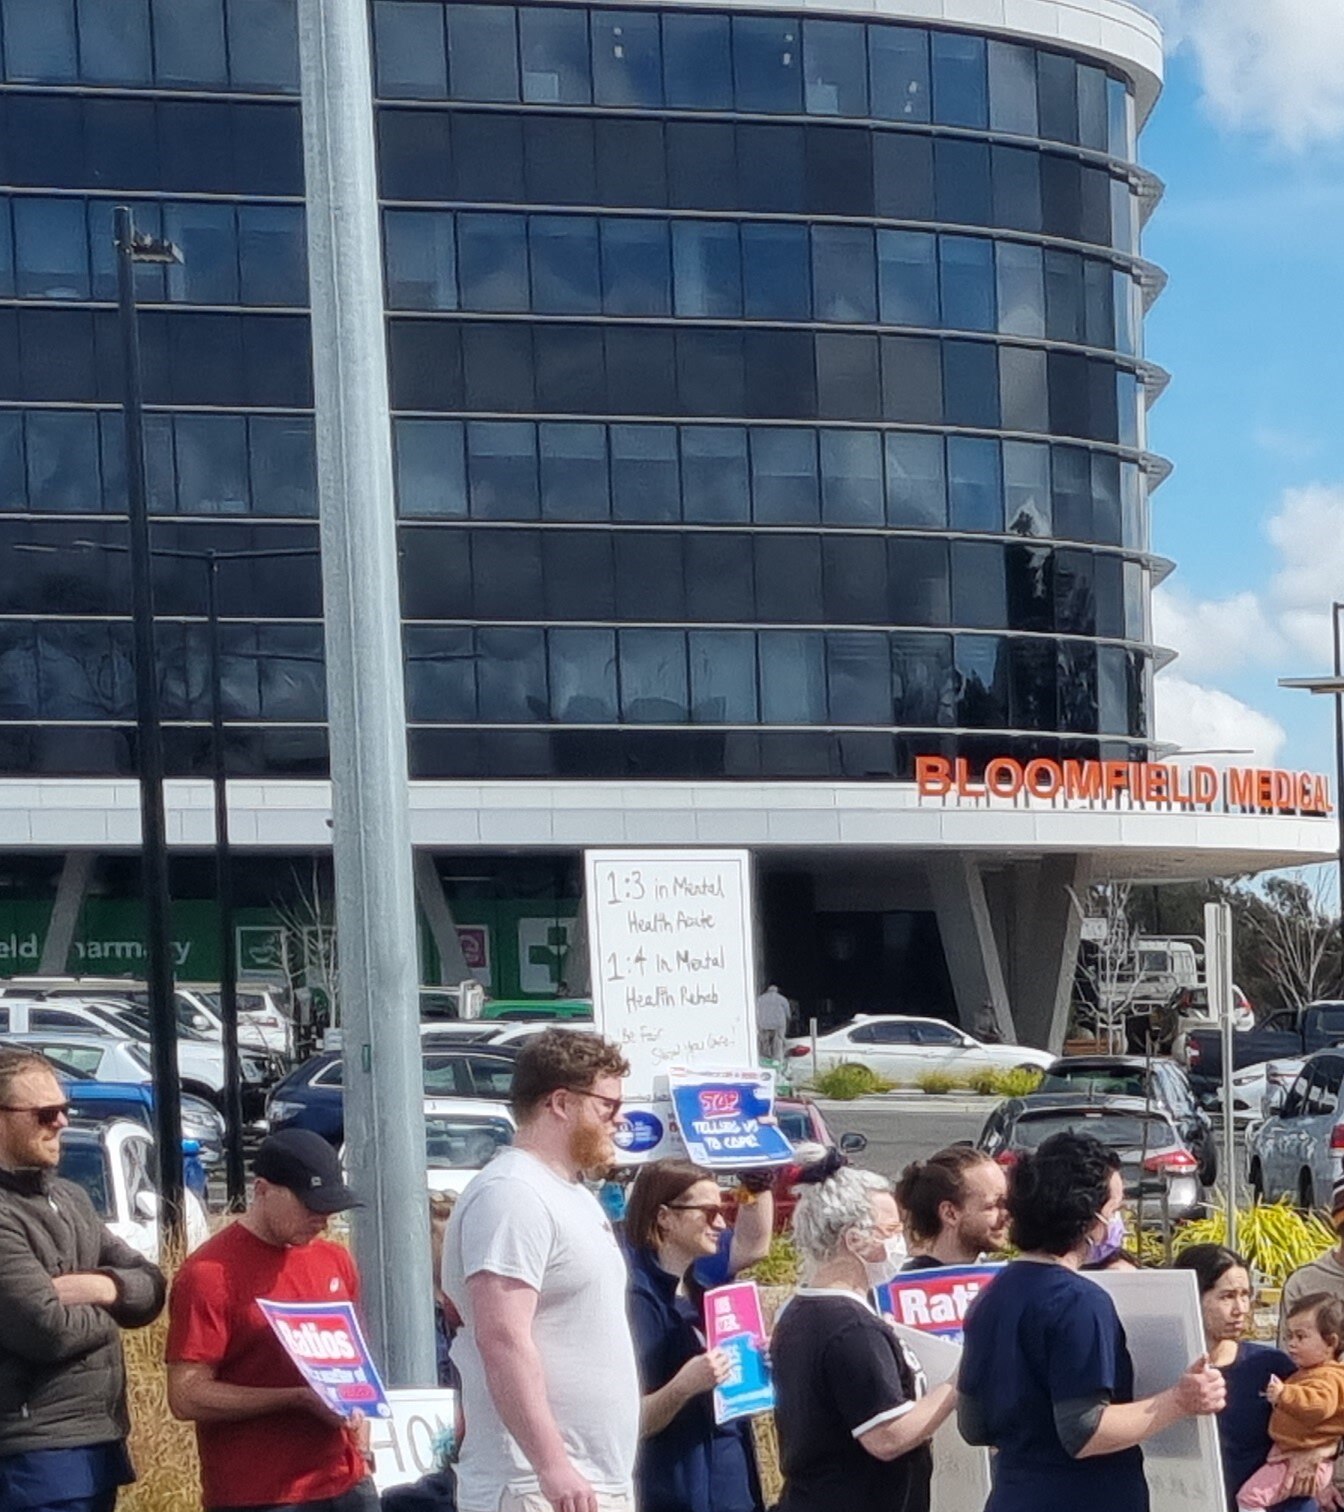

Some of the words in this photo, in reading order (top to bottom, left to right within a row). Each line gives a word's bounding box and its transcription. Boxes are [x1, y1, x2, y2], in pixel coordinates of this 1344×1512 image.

[914, 756, 1218, 804] BLOOMFIELD
[1228, 767, 1333, 812] MEDICAL
[607, 871, 645, 904] 1:3
[673, 874, 725, 898] Mental
[628, 910, 673, 934] Health
[677, 909, 715, 932] Acute
[74, 941, 191, 965] army
[607, 946, 647, 981] 1:4
[675, 946, 725, 972] Mental
[626, 984, 675, 1014] Health
[680, 983, 719, 1007] Rehab
